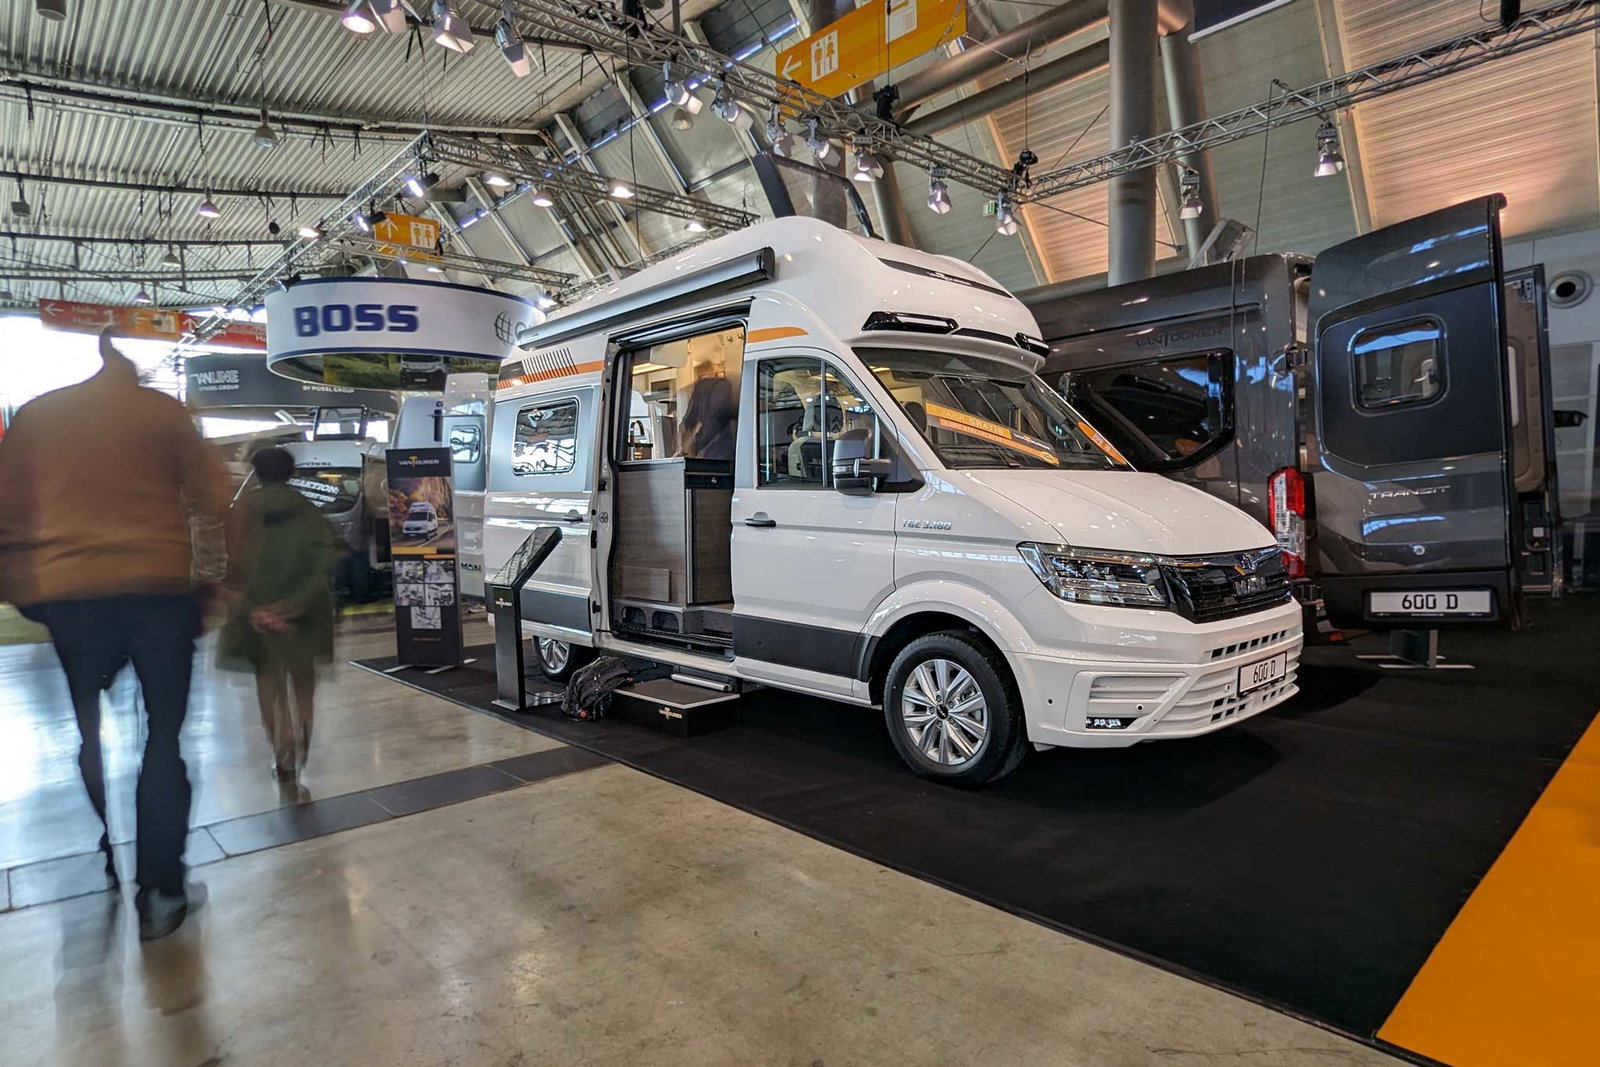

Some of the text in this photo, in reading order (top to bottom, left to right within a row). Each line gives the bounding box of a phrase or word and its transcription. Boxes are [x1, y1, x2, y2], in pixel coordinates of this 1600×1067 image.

[294, 303, 419, 337] BOSS
[398, 455, 440, 468] VANTOURER
[1369, 485, 1451, 499] TRANSIT
[902, 519, 952, 531] TGE 3.180
[1402, 594, 1458, 610] 600 D
[1253, 659, 1276, 684] 600 D
